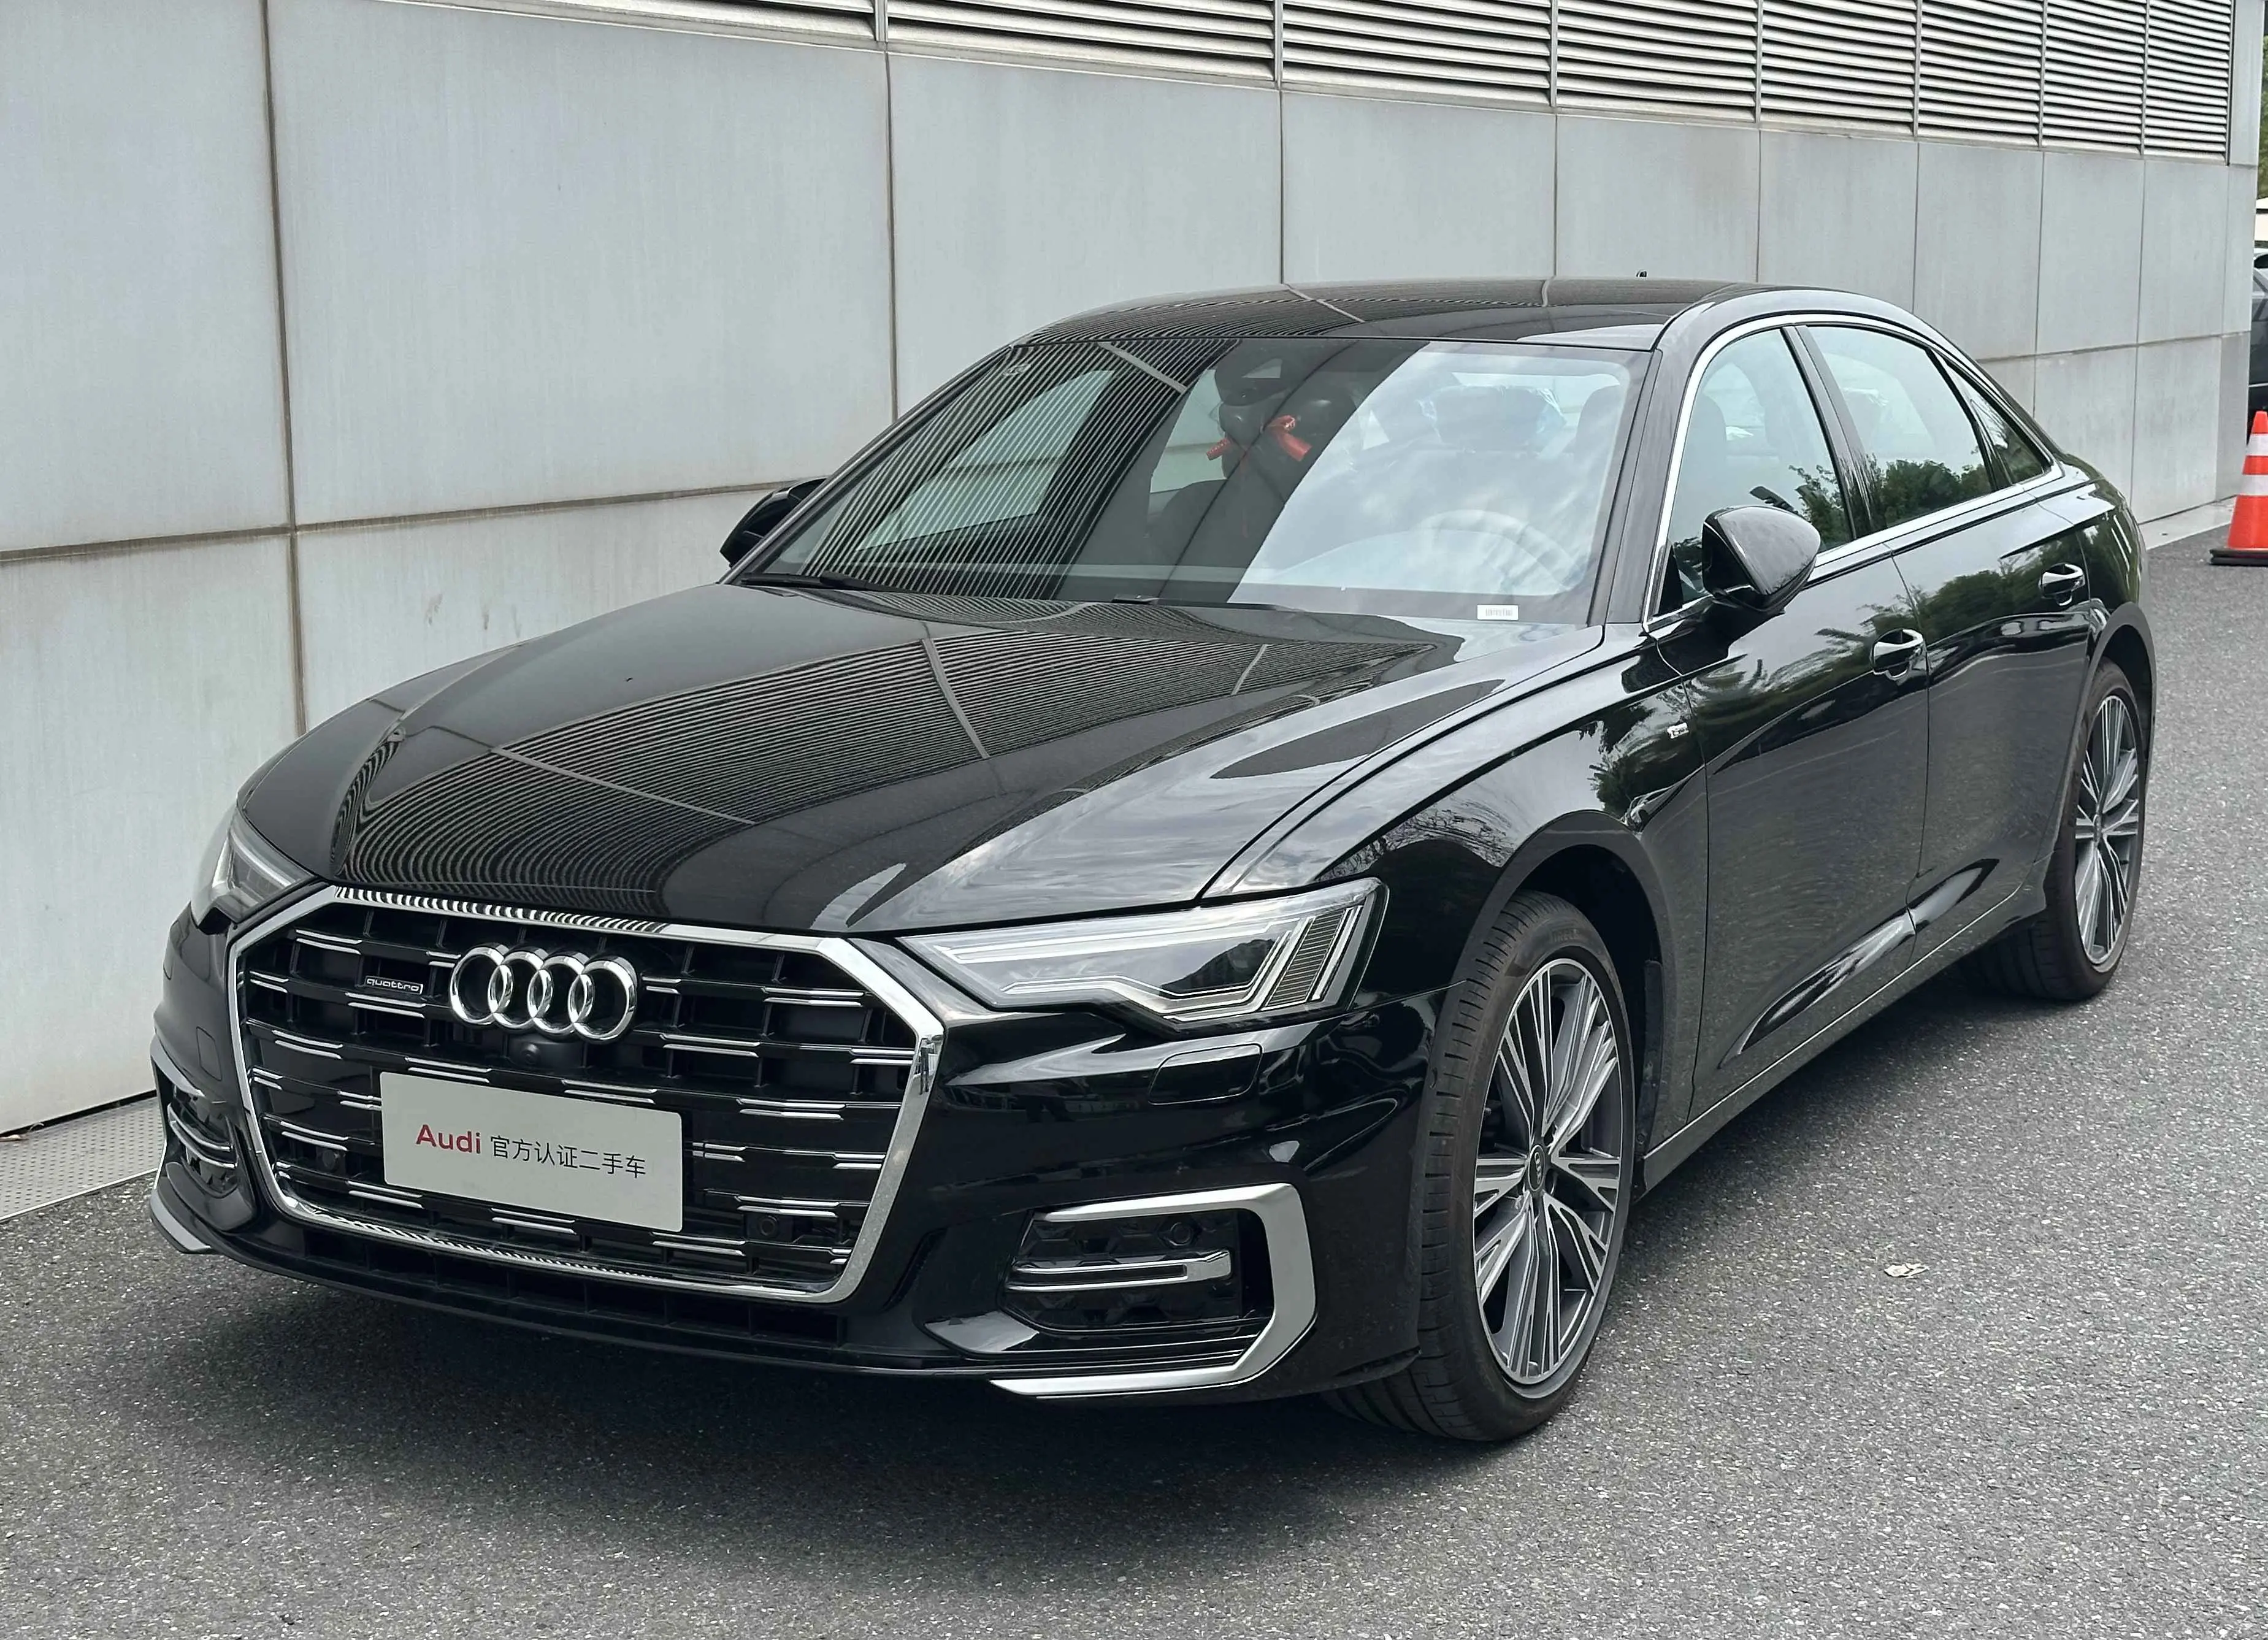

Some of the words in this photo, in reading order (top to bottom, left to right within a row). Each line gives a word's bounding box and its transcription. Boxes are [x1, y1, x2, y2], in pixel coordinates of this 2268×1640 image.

[367, 978, 420, 992] quattro
[416, 1124, 481, 1154] Audi
[491, 1135, 646, 1178] 官方认证二手车
